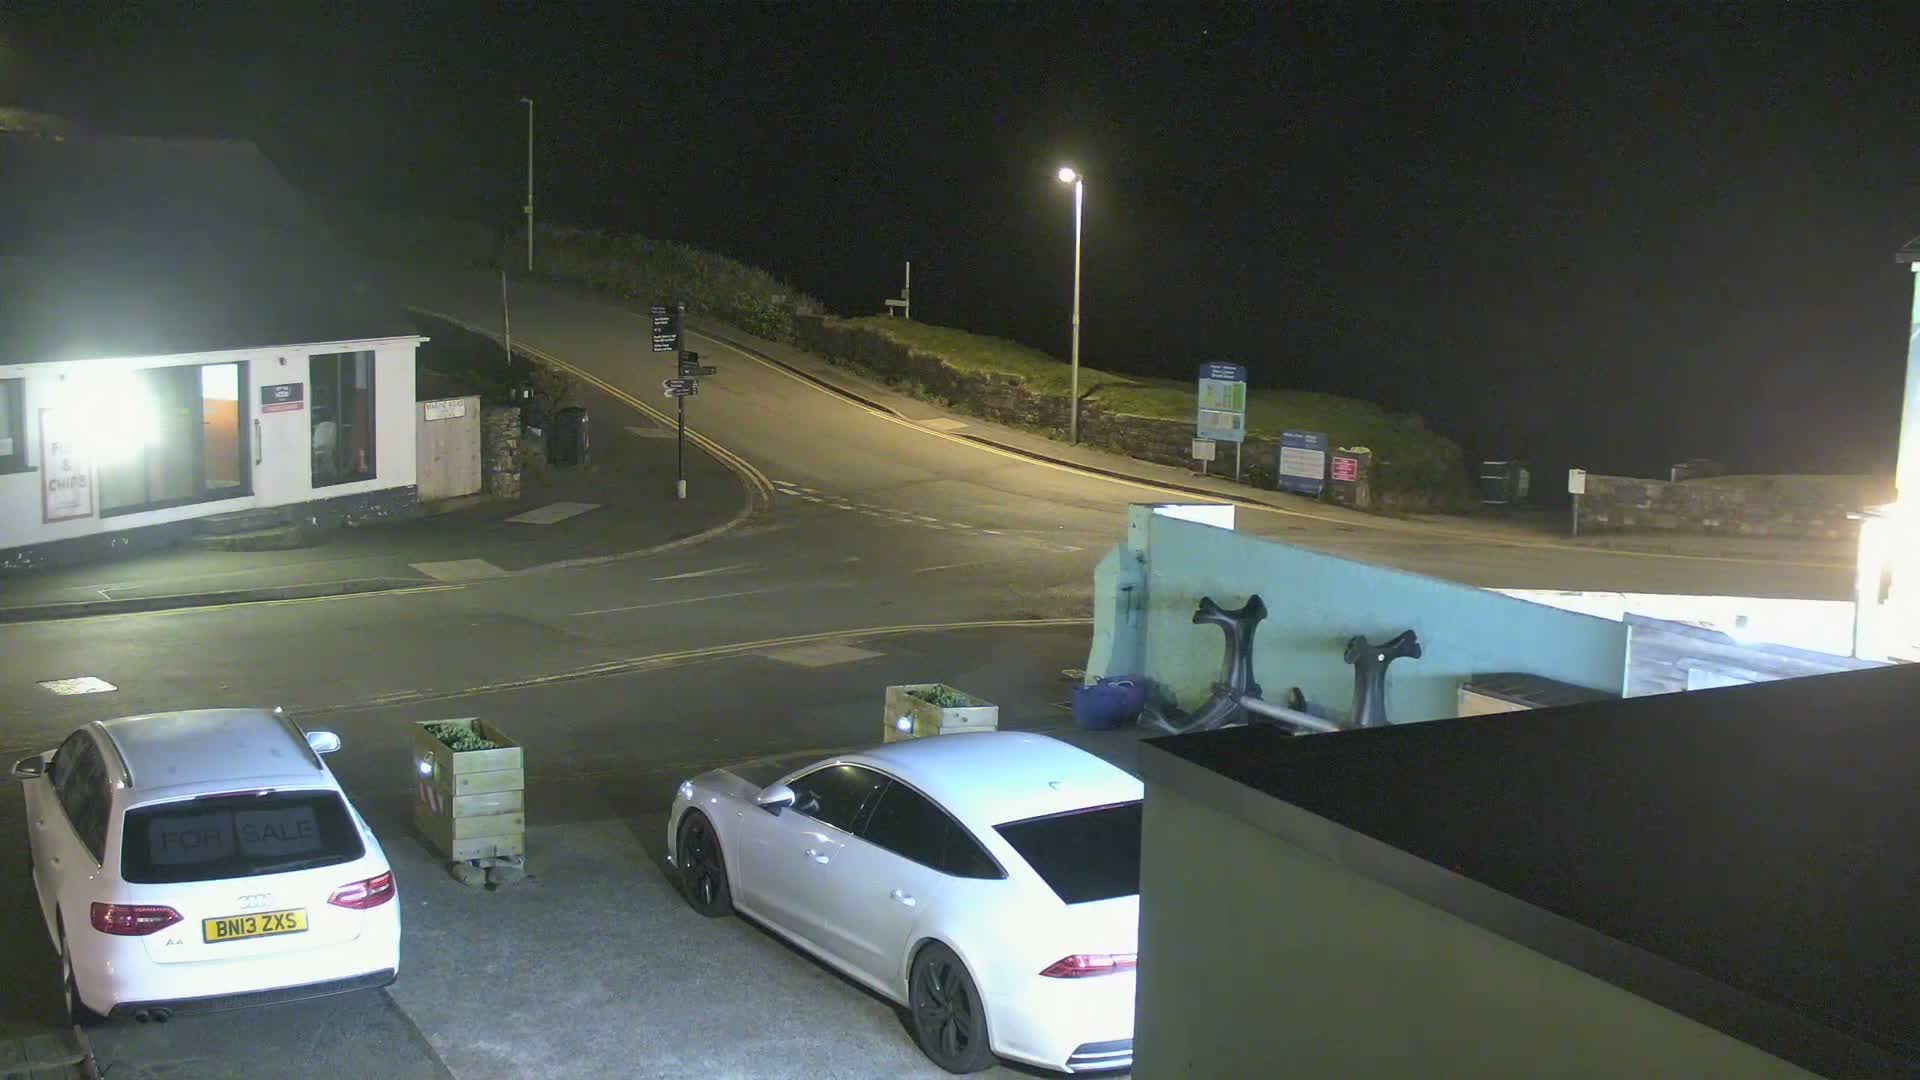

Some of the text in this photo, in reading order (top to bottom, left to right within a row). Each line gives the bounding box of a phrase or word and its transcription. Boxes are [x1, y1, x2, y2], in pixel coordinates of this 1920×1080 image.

[449, 399, 464, 407] ROAD
[48, 475, 87, 491] CHIPS
[161, 830, 222, 849] FOR
[241, 819, 312, 841] SALE
[216, 912, 297, 937] BN13 ZXS
